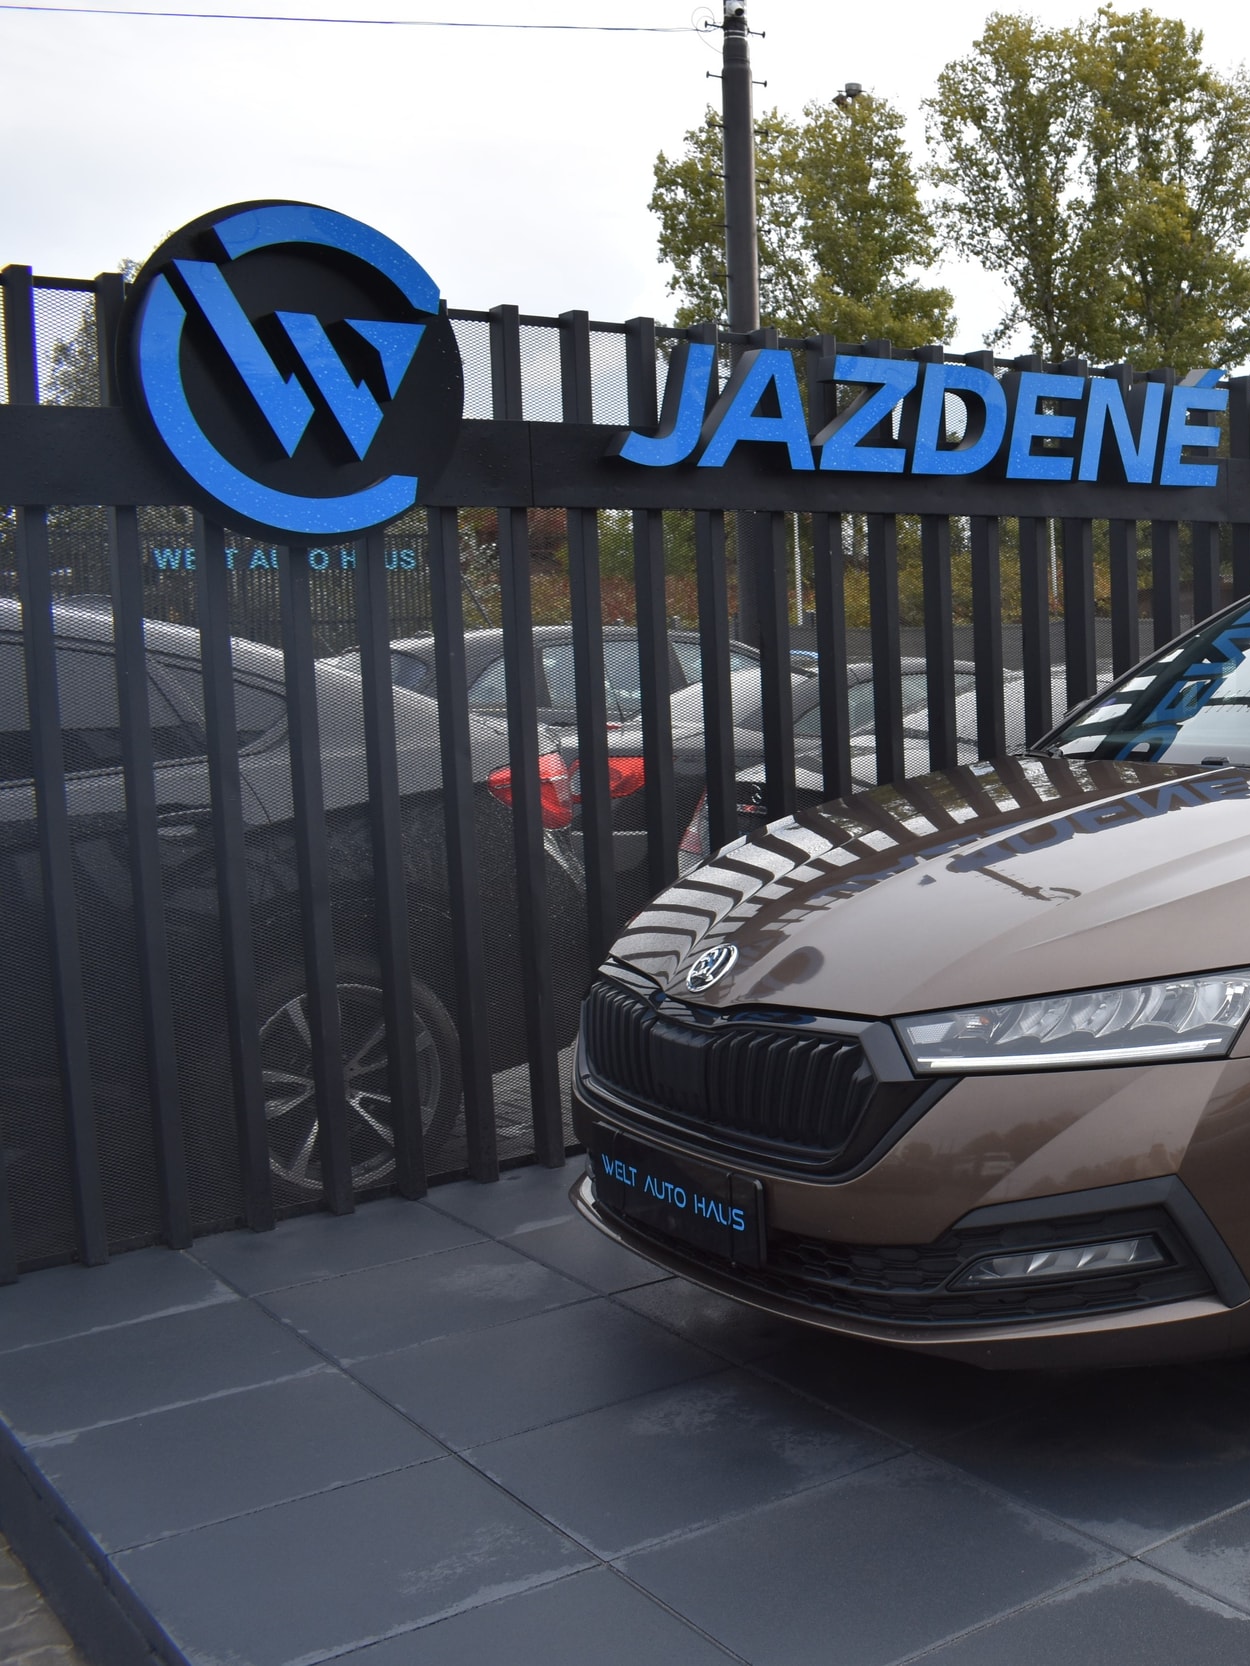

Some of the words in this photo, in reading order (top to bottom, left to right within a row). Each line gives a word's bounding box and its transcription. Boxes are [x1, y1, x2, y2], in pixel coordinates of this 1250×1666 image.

[619, 343, 1229, 486] JAZDENÉ
[153, 548, 238, 570] WET
[340, 548, 417, 570] HUS
[601, 1153, 637, 1187] WELT
[644, 1175, 687, 1208] AUTO
[694, 1193, 745, 1231] HAUS
